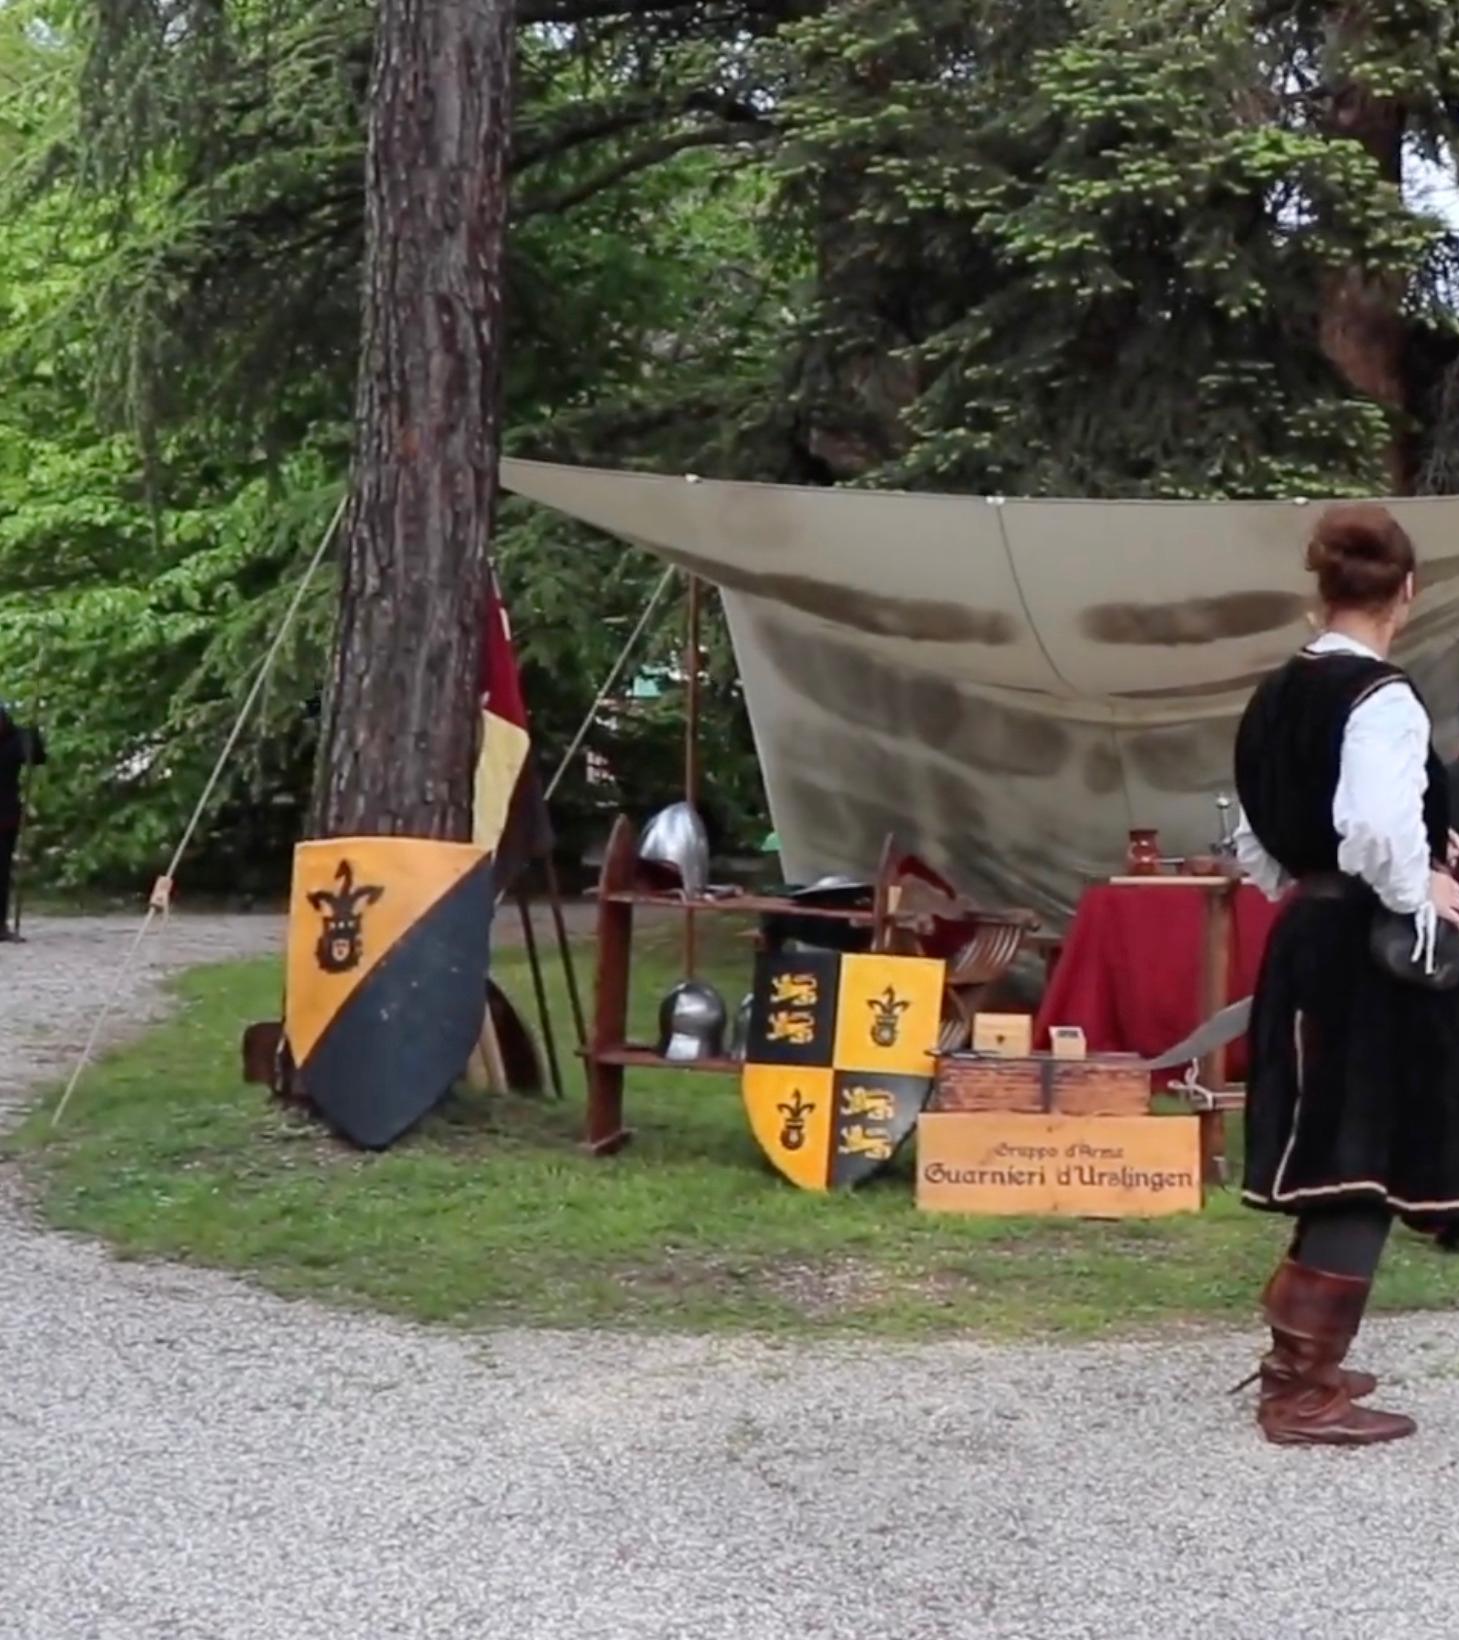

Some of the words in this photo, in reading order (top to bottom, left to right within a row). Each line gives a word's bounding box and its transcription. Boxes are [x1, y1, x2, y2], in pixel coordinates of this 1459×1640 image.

[994, 1142, 1059, 1160] Gruppo
[924, 1162, 1046, 1187] Guarnieri
[1056, 1164, 1194, 1193] d'Urslingen
